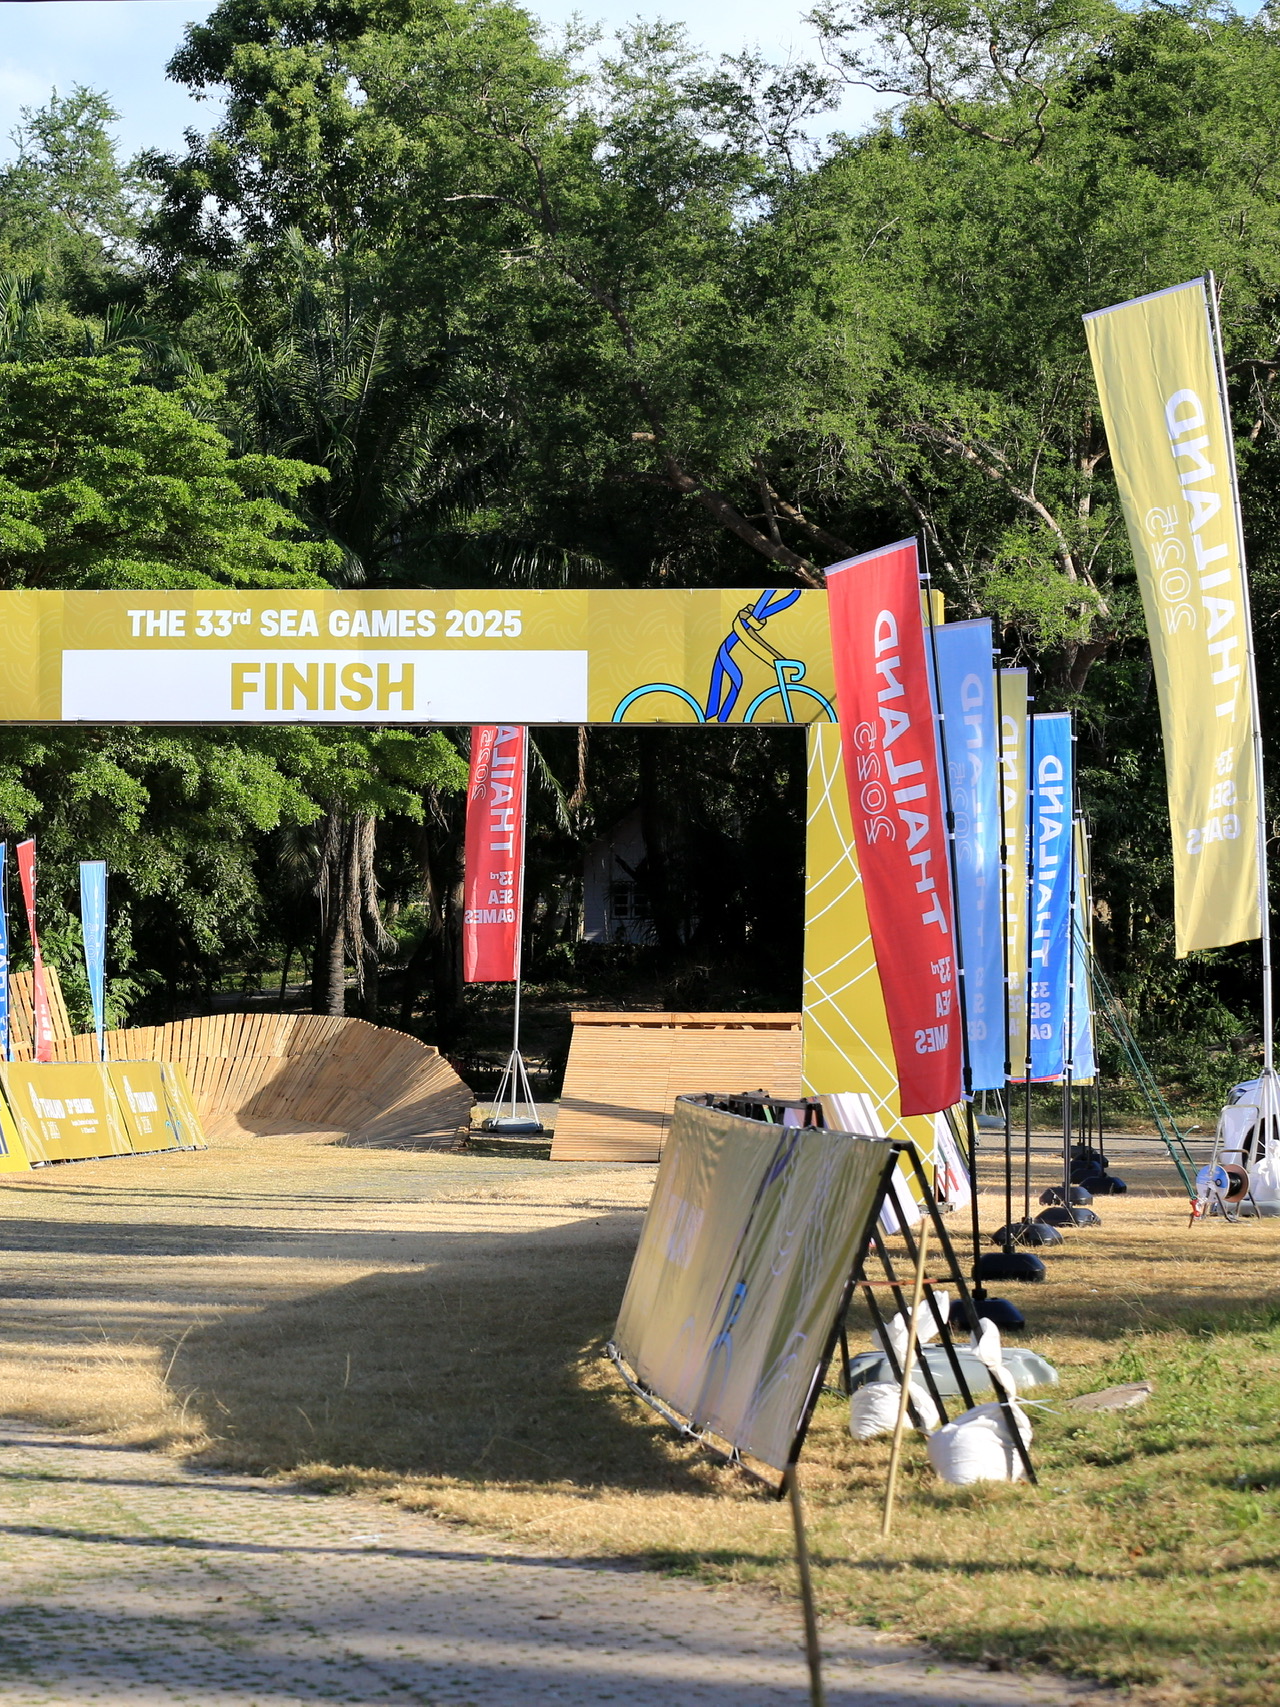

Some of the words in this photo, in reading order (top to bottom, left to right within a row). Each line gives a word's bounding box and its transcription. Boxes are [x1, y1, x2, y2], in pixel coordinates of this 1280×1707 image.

[128, 610, 186, 636] THE
[195, 609, 251, 637] 33rd
[260, 610, 319, 636] SEA
[329, 610, 436, 637] GAMES
[446, 610, 522, 637] 2025
[232, 663, 413, 710] FINISH
